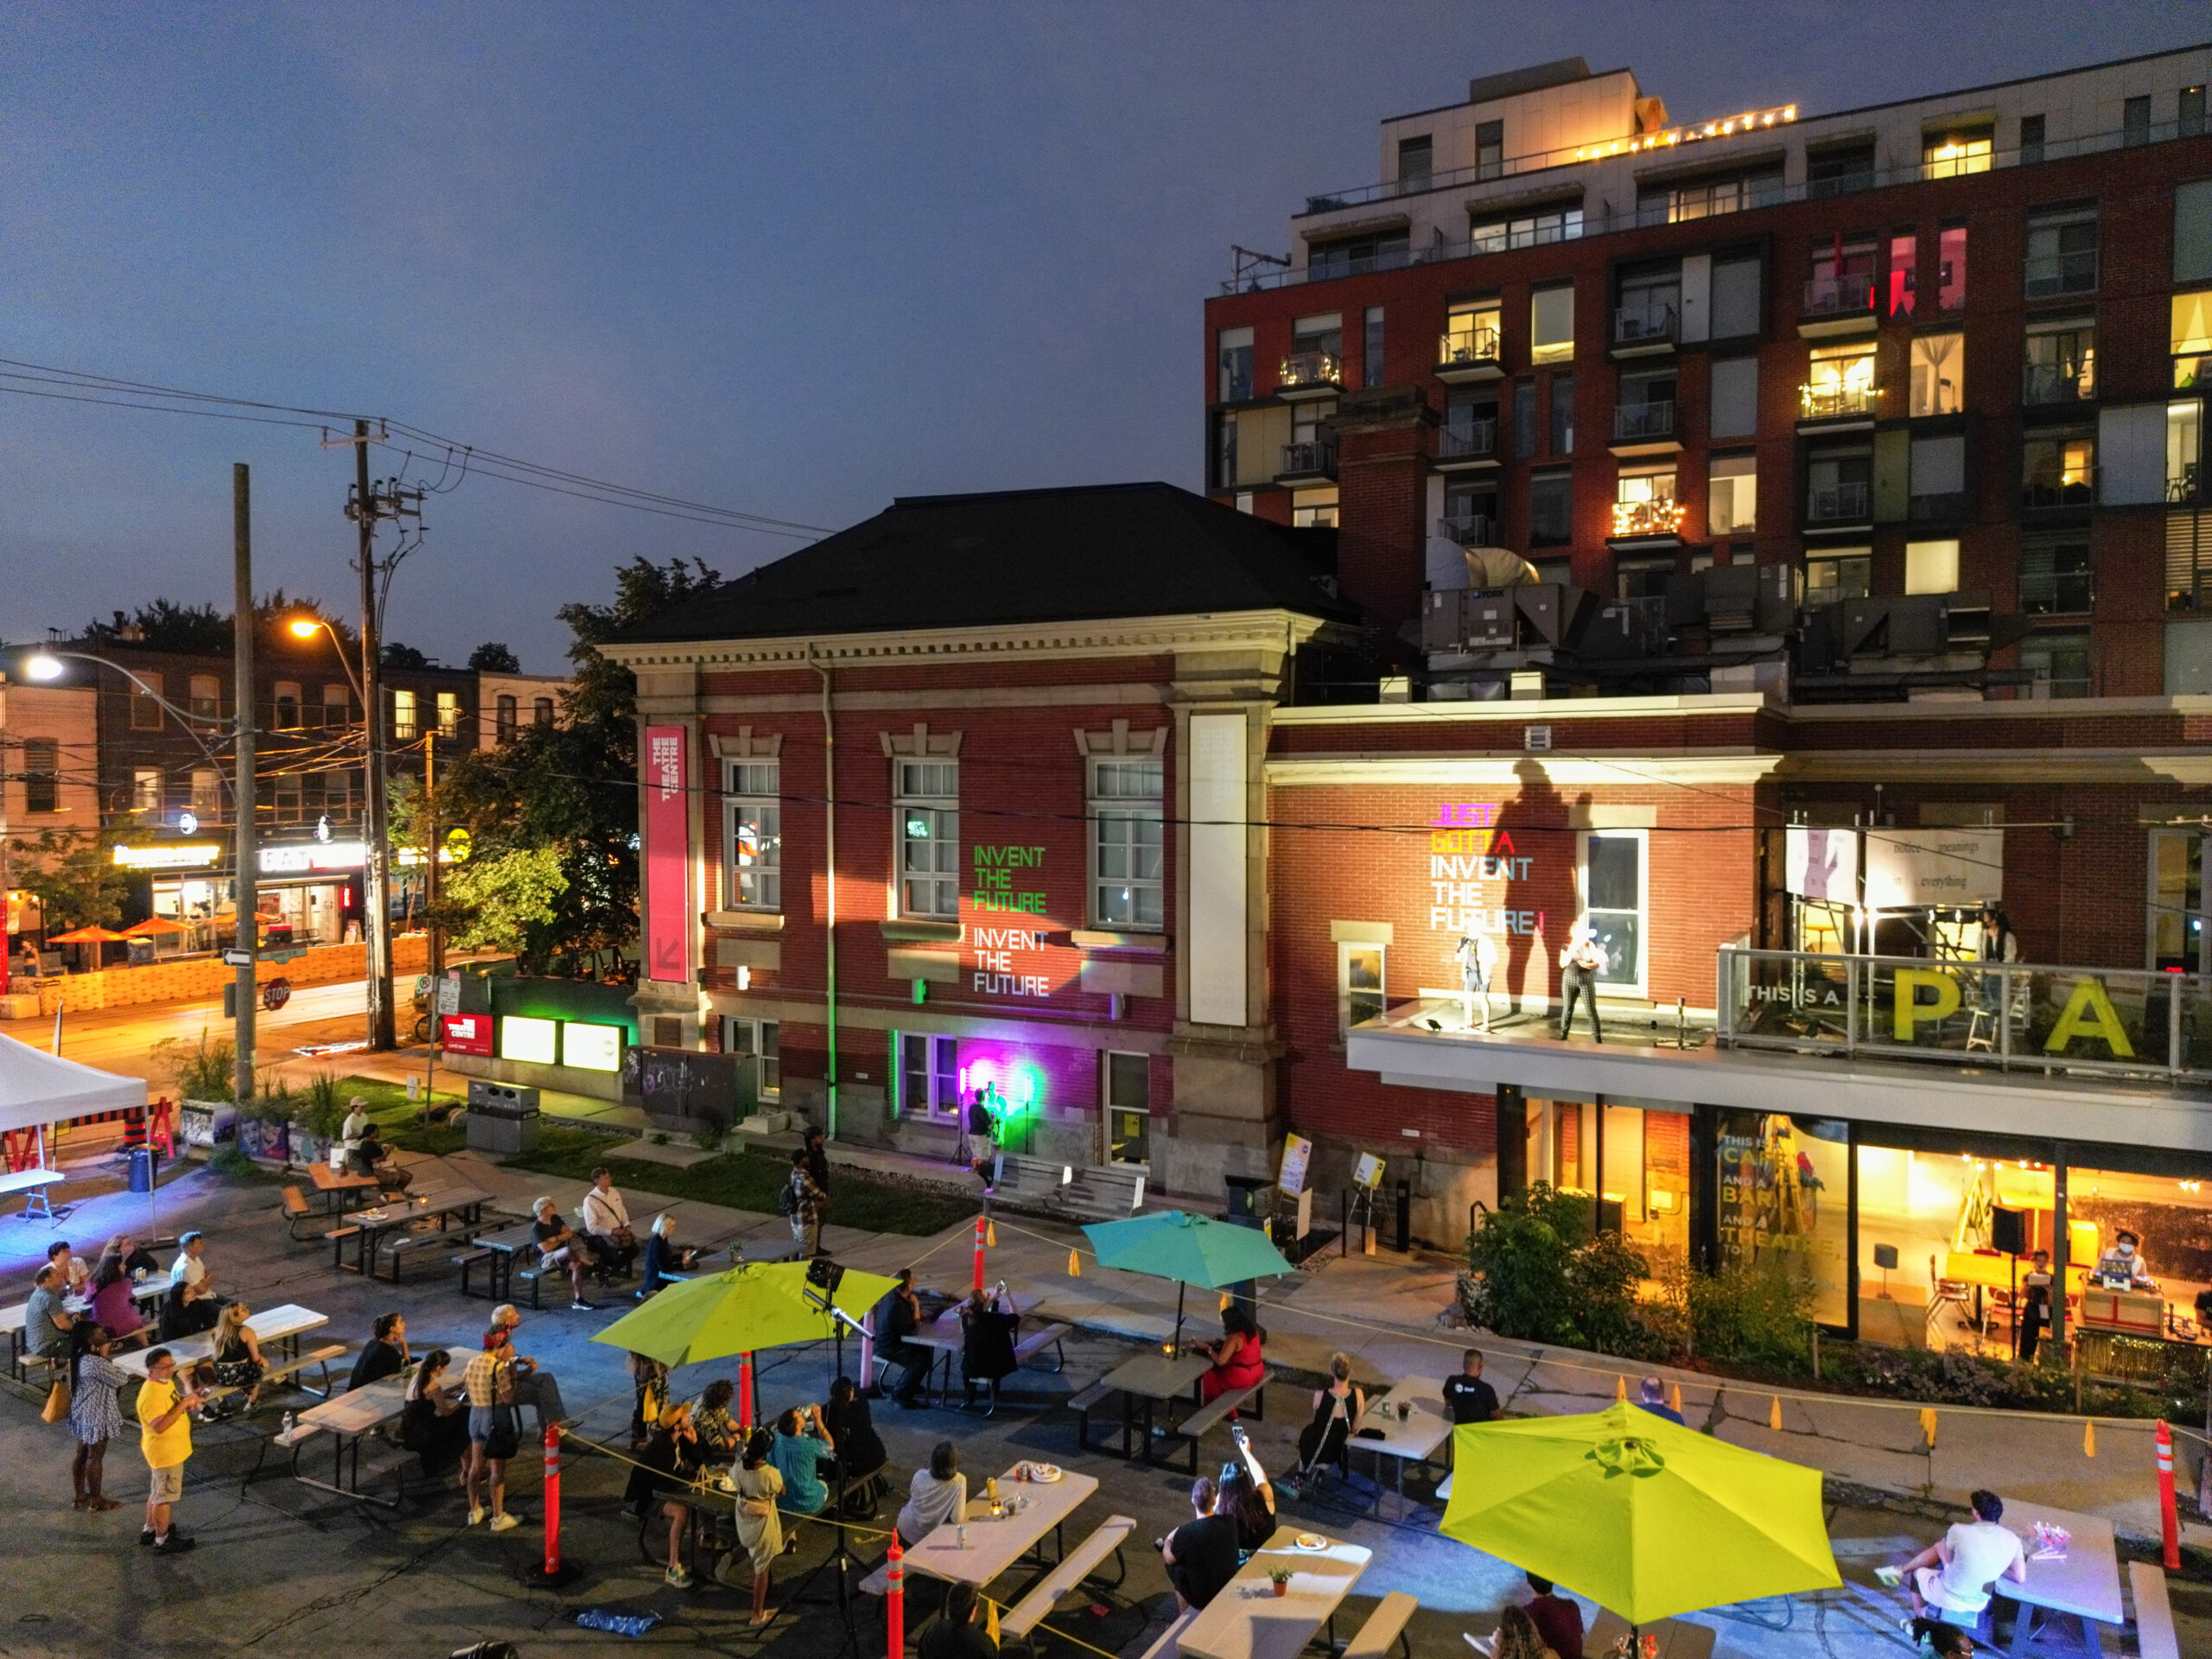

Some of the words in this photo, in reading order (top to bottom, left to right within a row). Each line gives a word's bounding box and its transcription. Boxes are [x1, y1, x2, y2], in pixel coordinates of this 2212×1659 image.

[652, 737, 661, 766] THE
[661, 737, 671, 802] THEATRE
[671, 737, 679, 794] CENTRE
[1431, 804, 1496, 826] JUST
[1432, 830, 1516, 854] GOTTA
[1893, 841, 1921, 854] notice
[1938, 841, 1980, 855] meanings
[974, 846, 1046, 868] INVENT
[1430, 855, 1534, 881] INVENT
[974, 868, 1011, 889] THE
[1921, 874, 1967, 890] everything
[973, 891, 1046, 913] FUTURE
[1430, 881, 1483, 906] THE
[974, 927, 1049, 951] INVENT
[974, 950, 1012, 972] THE
[264, 986, 290, 1002] STOP
[974, 972, 1050, 998] FUTURE
[1745, 985, 1791, 1001] THIS
[1798, 988, 1817, 1004] IS
[1823, 989, 1840, 1006] A
[1724, 1135, 1753, 1147] THIS
[1724, 1174, 1753, 1187] AND
[1756, 1178, 1767, 1189] A
[1723, 1214, 1753, 1227] AND
[1756, 1215, 1768, 1229] A
